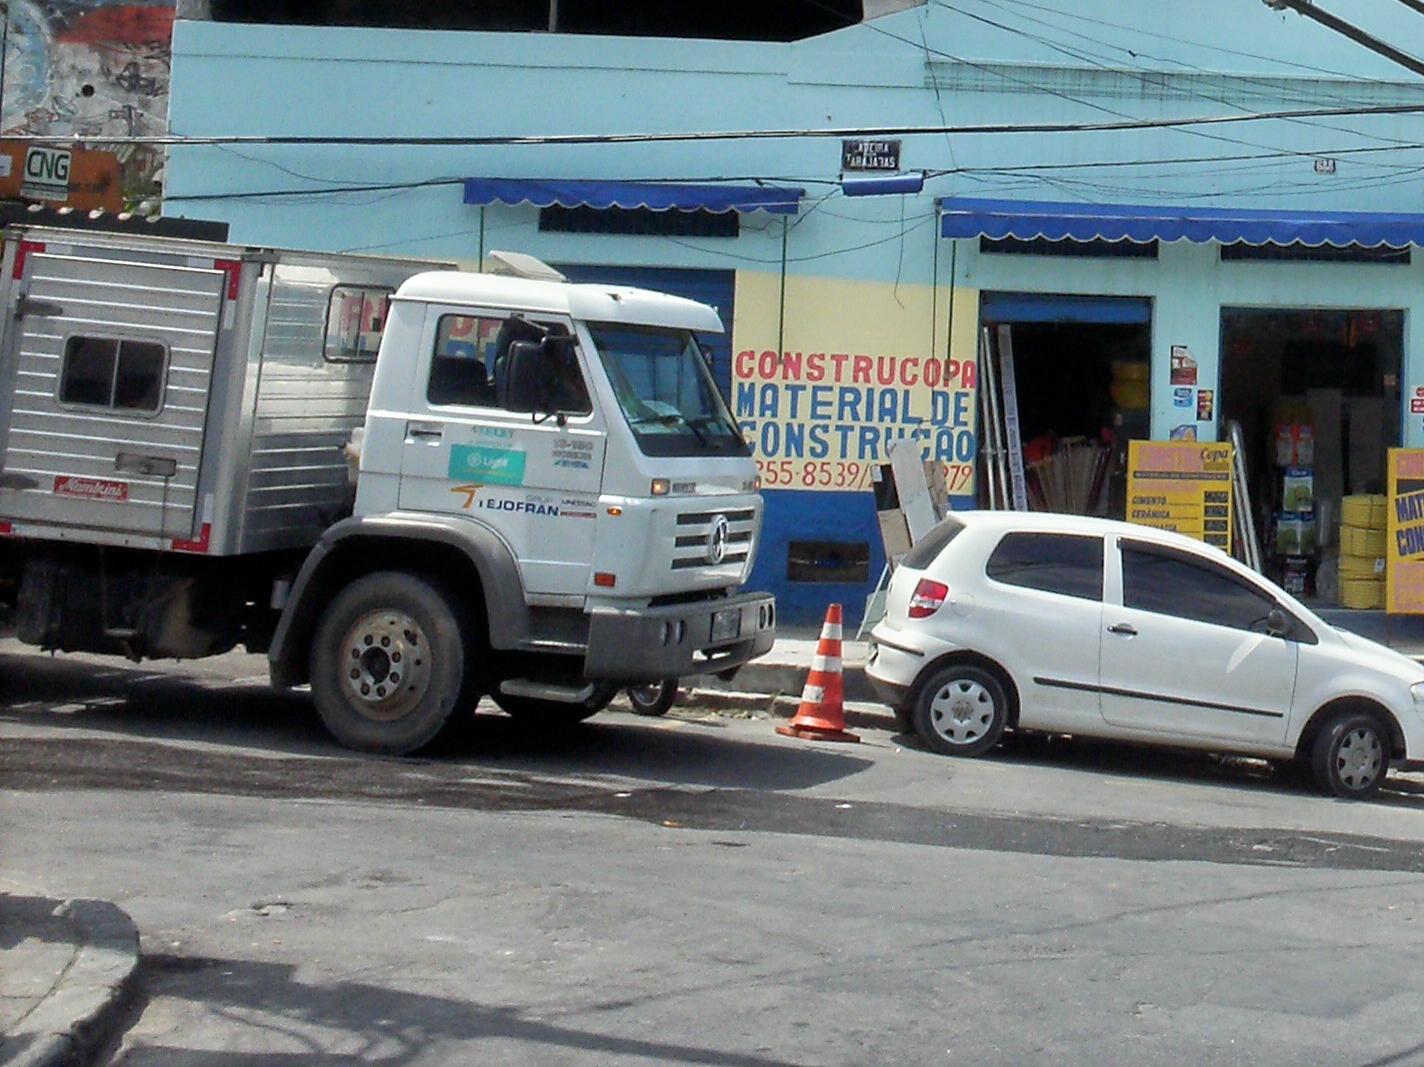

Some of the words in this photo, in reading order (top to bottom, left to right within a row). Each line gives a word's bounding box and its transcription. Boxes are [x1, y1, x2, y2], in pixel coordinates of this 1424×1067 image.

[854, 142, 889, 152] ADEIRA
[27, 151, 70, 180] CNG
[735, 350, 977, 389] CONSTRUCOPA
[736, 382, 923, 425] MATERIAL
[932, 389, 970, 428] DE
[1201, 447, 1229, 462] Copa
[1132, 496, 1167, 506] CIMENTO
